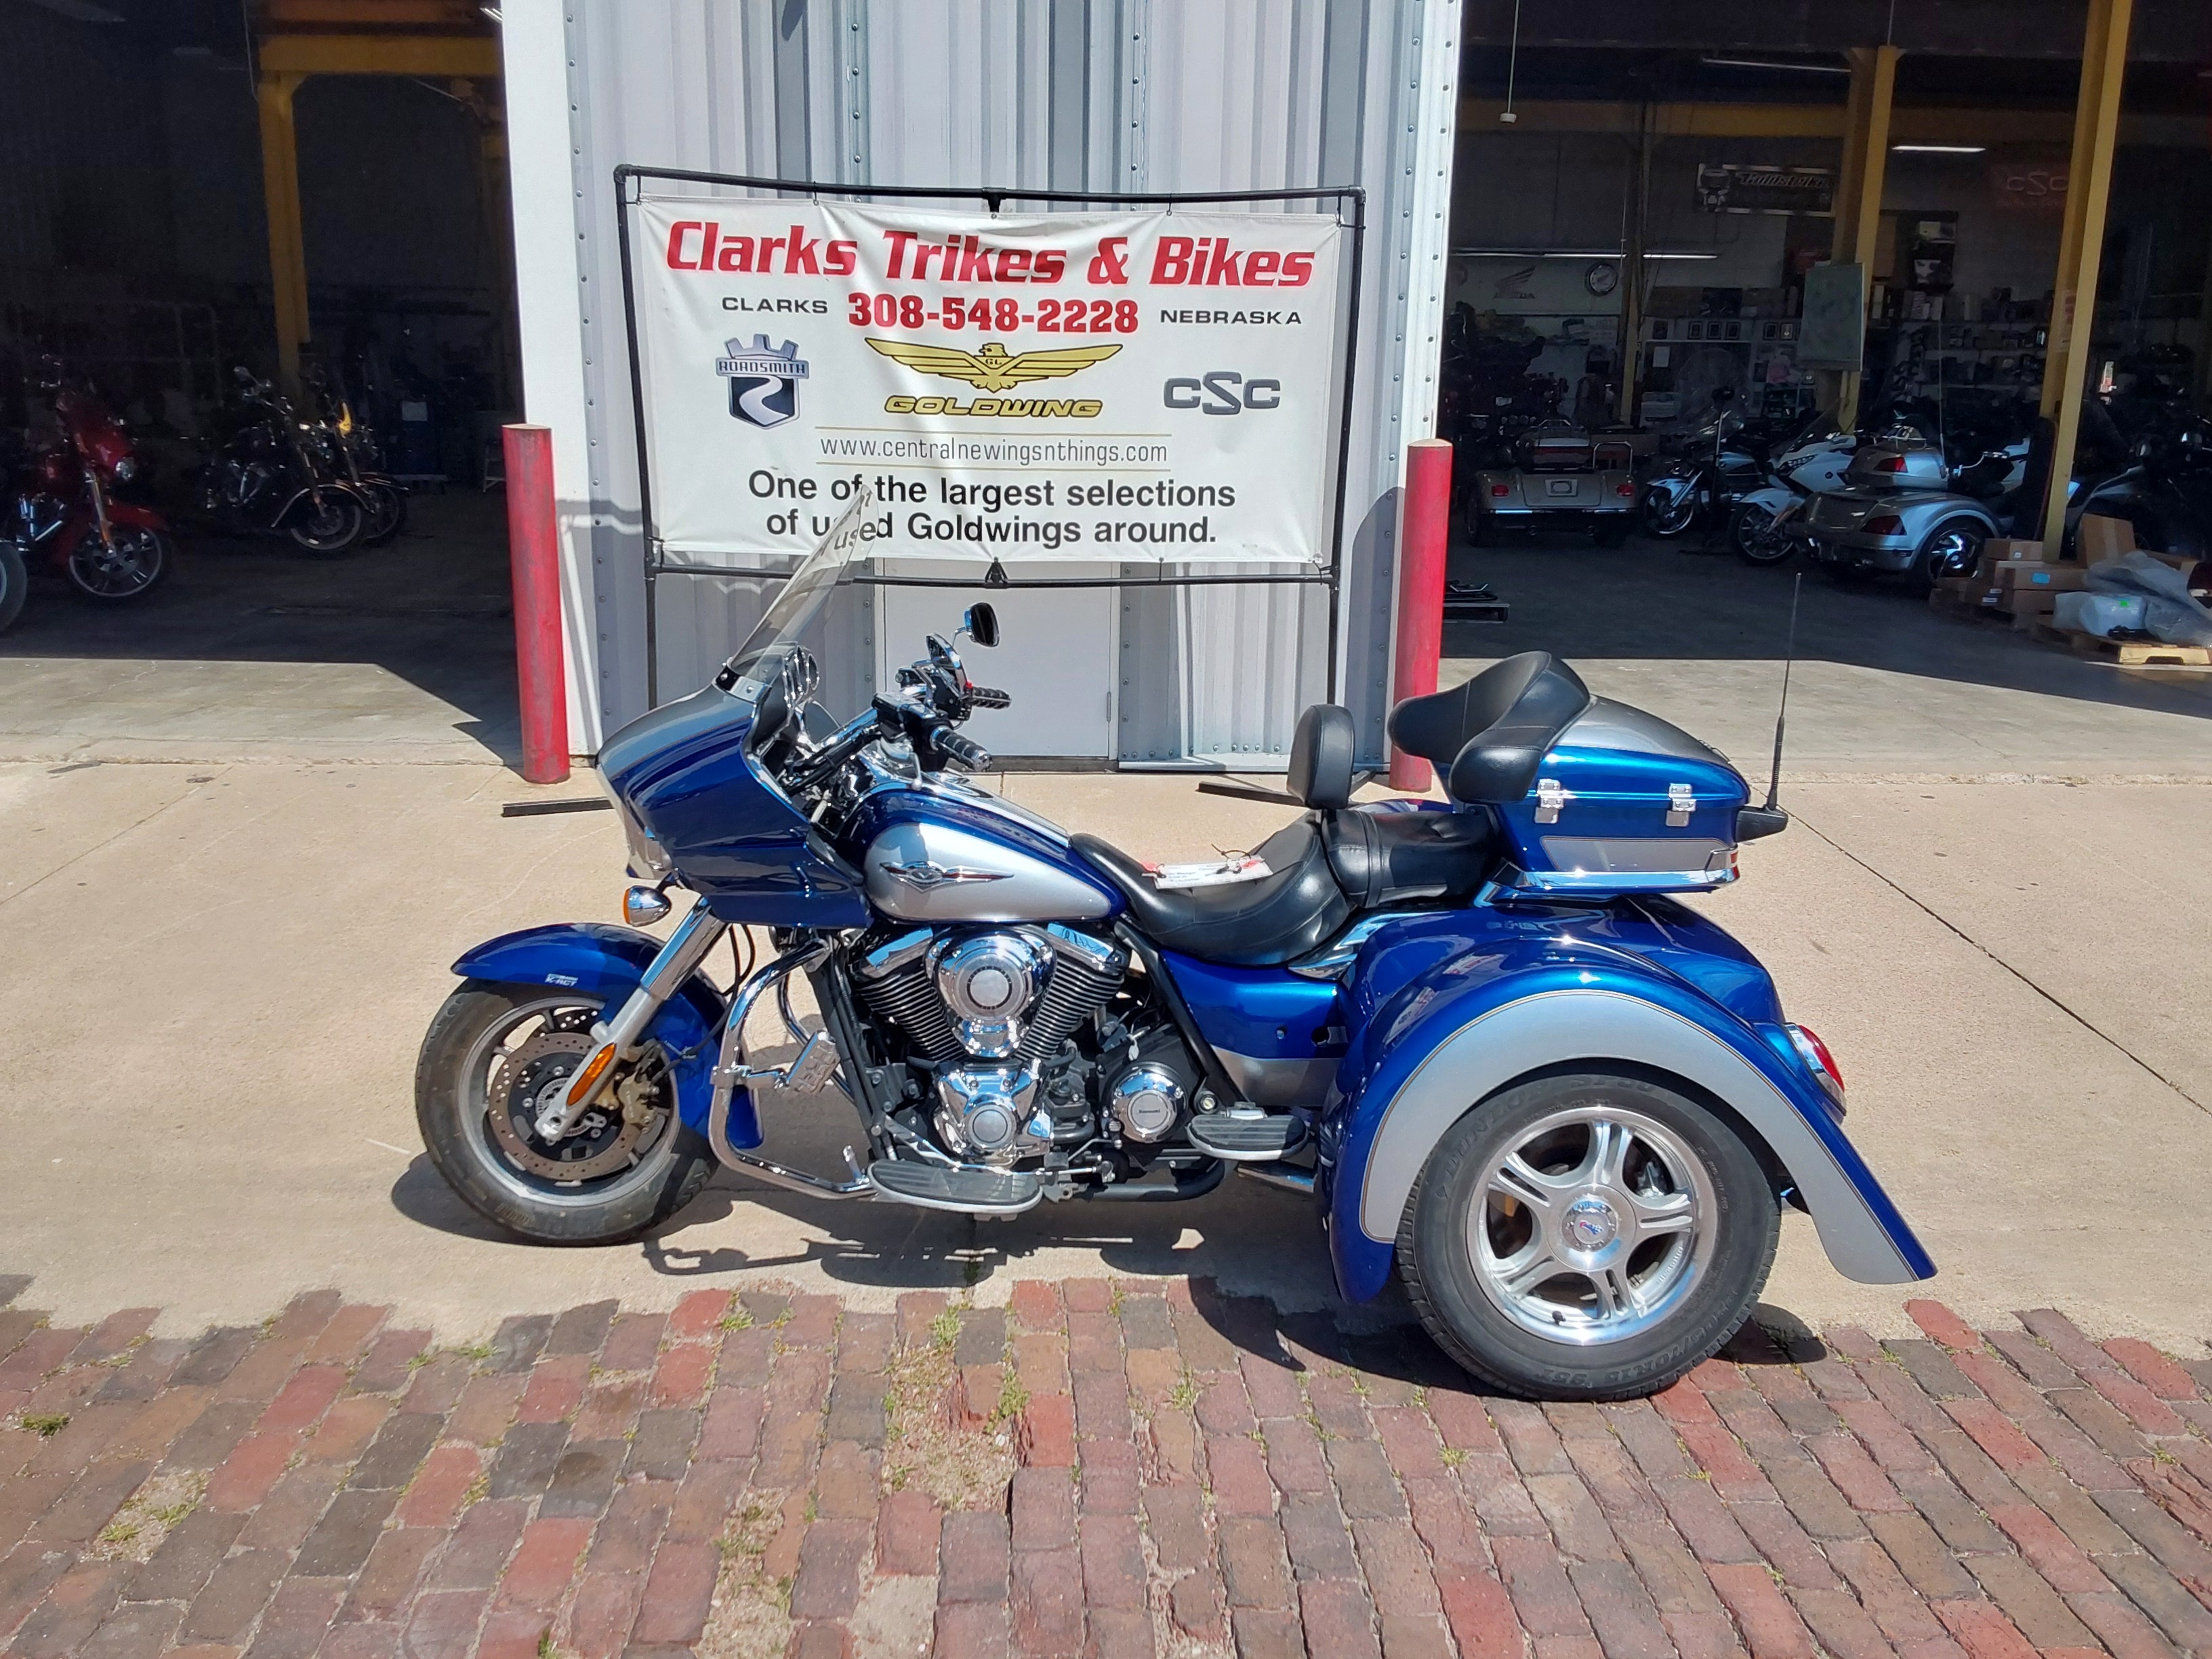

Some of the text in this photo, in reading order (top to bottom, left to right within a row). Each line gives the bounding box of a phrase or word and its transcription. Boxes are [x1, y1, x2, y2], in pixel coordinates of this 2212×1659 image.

[666, 221, 1315, 287] Clarks Trikes & Bikes
[722, 296, 828, 314] CLARKS
[848, 292, 1139, 333] 308-548-2228
[1160, 309, 1302, 325] NEBRASKA
[719, 361, 805, 374] ROADSMITH
[985, 358, 1003, 366] GL
[884, 395, 1103, 417] GOLDWING
[1163, 371, 1281, 415] CSC
[820, 437, 1167, 466] www.centralnewingsnthings.com
[749, 470, 1236, 513] One of the largest selections
[766, 508, 1217, 550] of ued Goldwings around.
